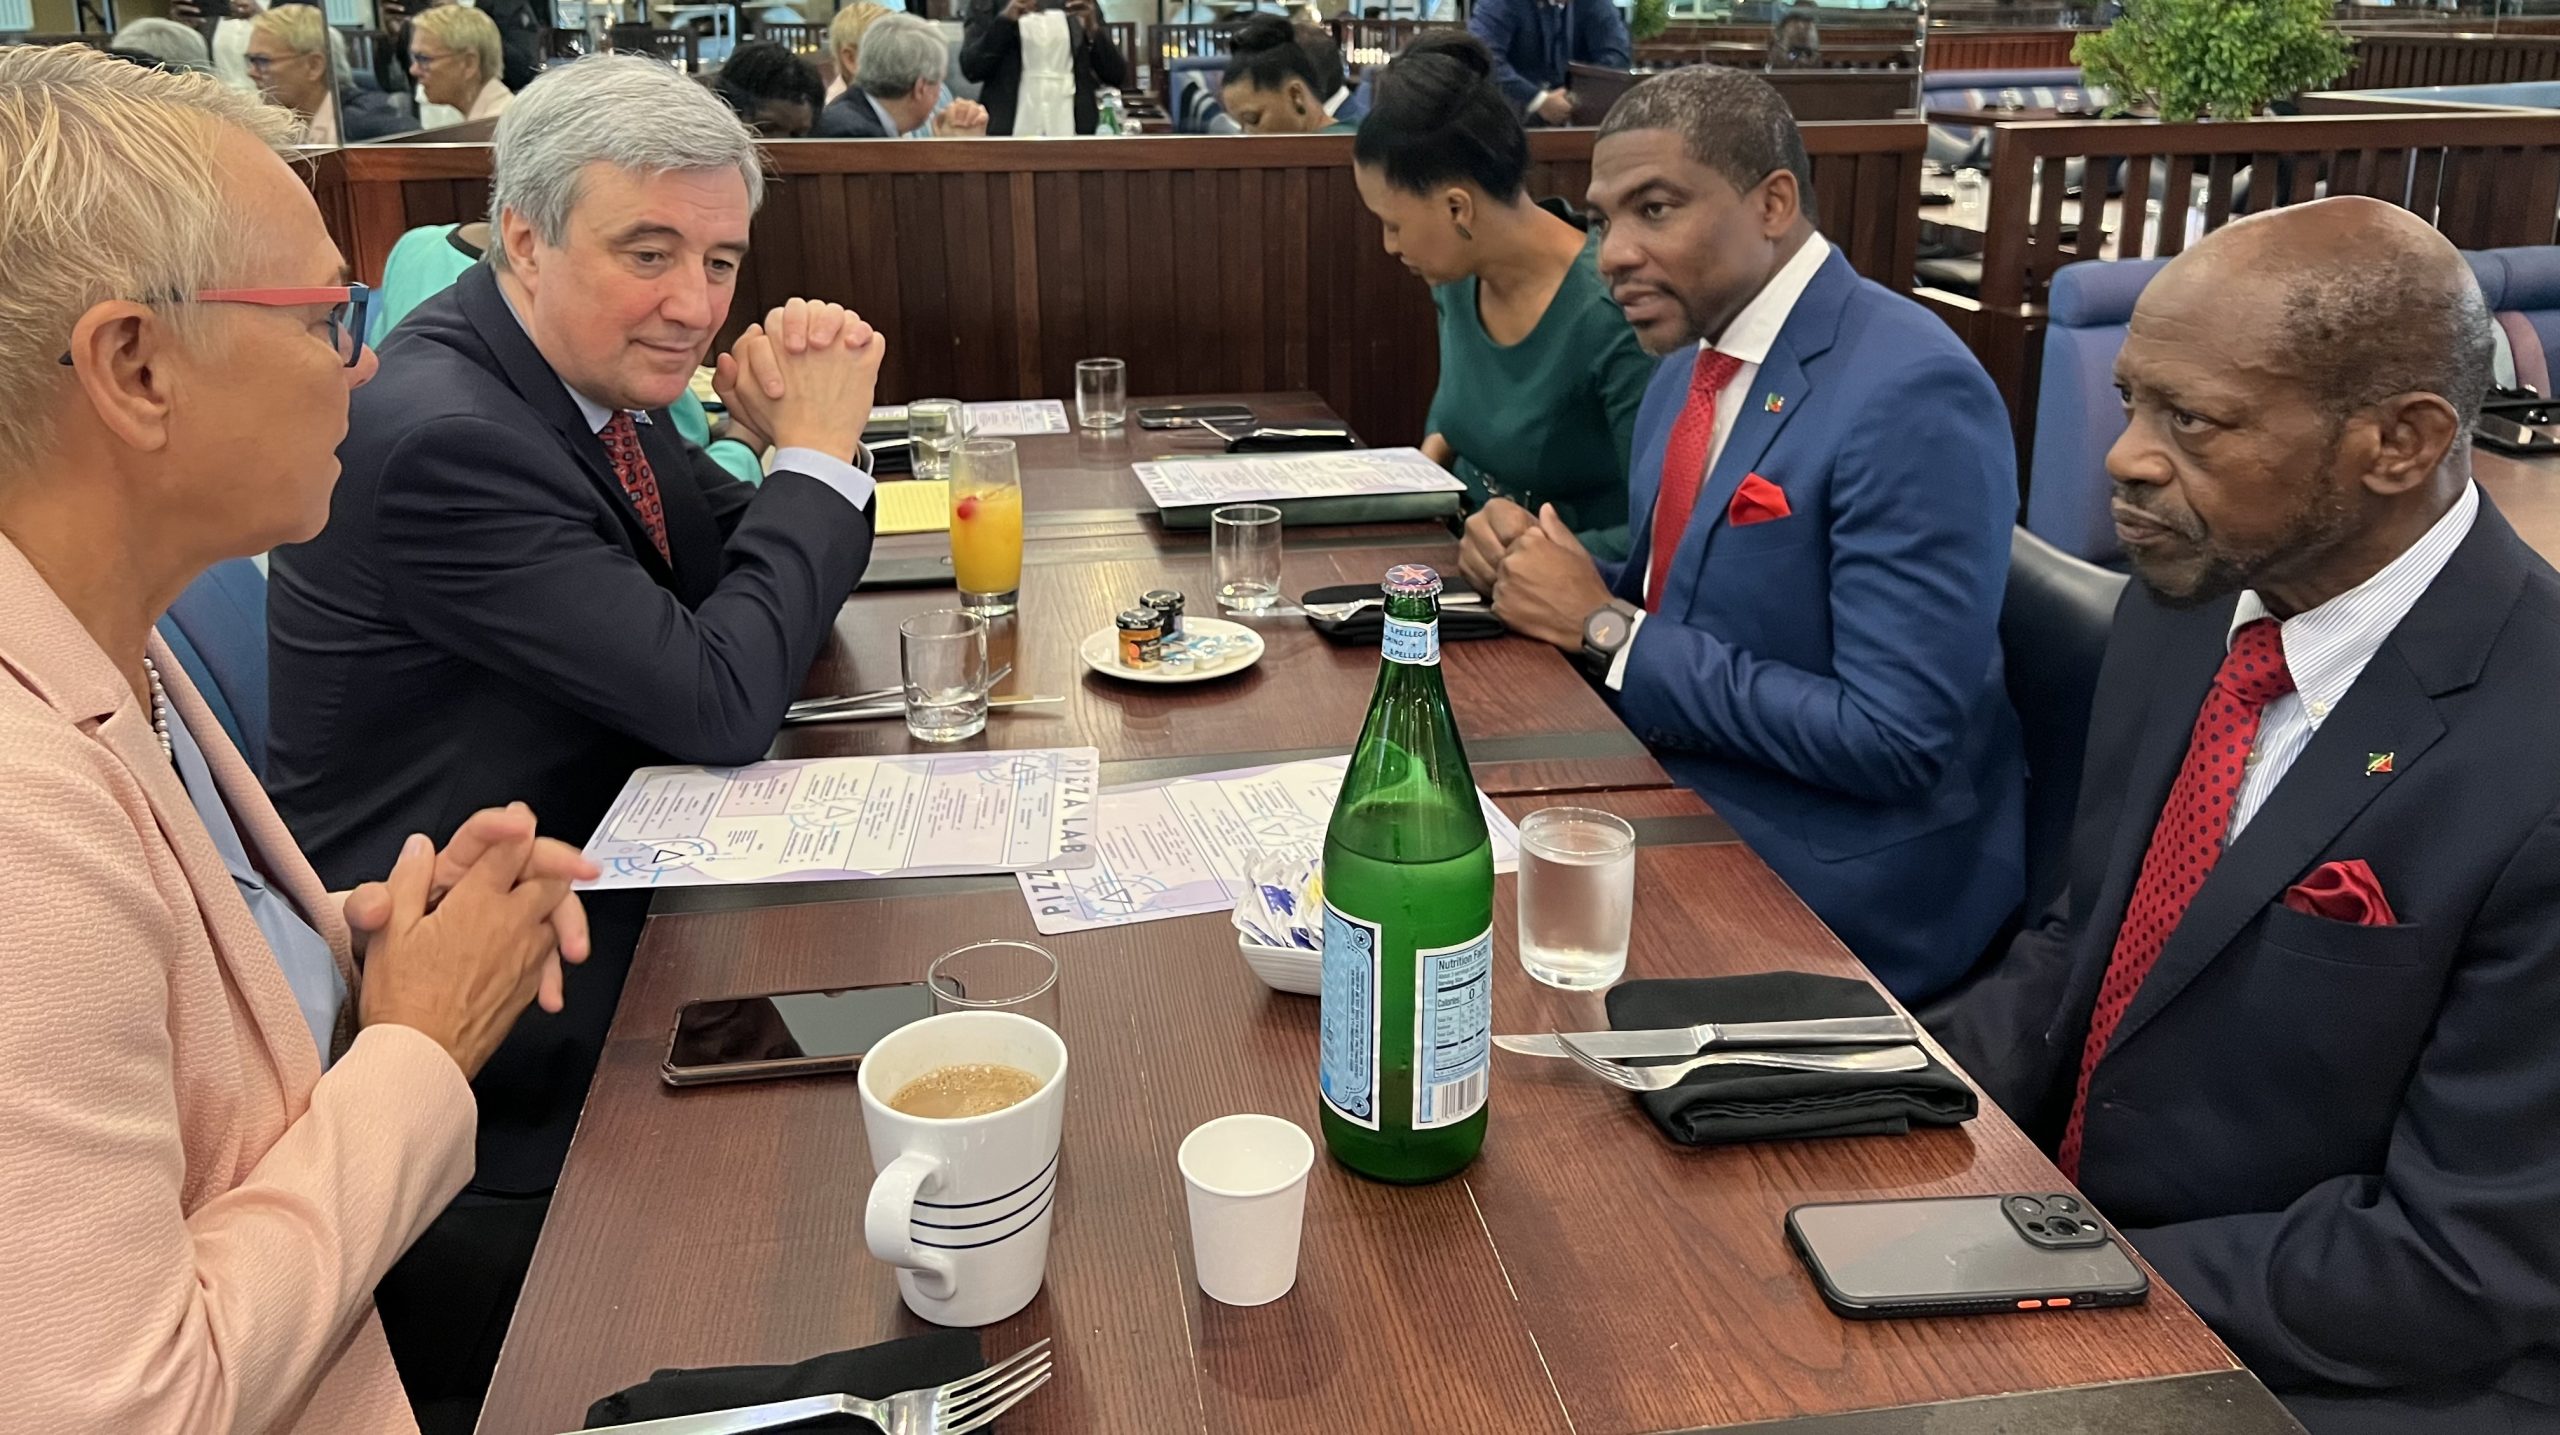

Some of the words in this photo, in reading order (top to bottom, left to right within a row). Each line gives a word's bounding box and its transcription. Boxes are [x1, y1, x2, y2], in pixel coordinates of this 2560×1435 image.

[1063, 759, 1090, 808] PIZZA
[1060, 818, 1088, 853] LAB
[1026, 870, 1071, 916] PIZZ
[1438, 955, 1472, 970] Nutrition
[1438, 997, 1460, 1007] Calories
[1469, 988, 1475, 999] 0
